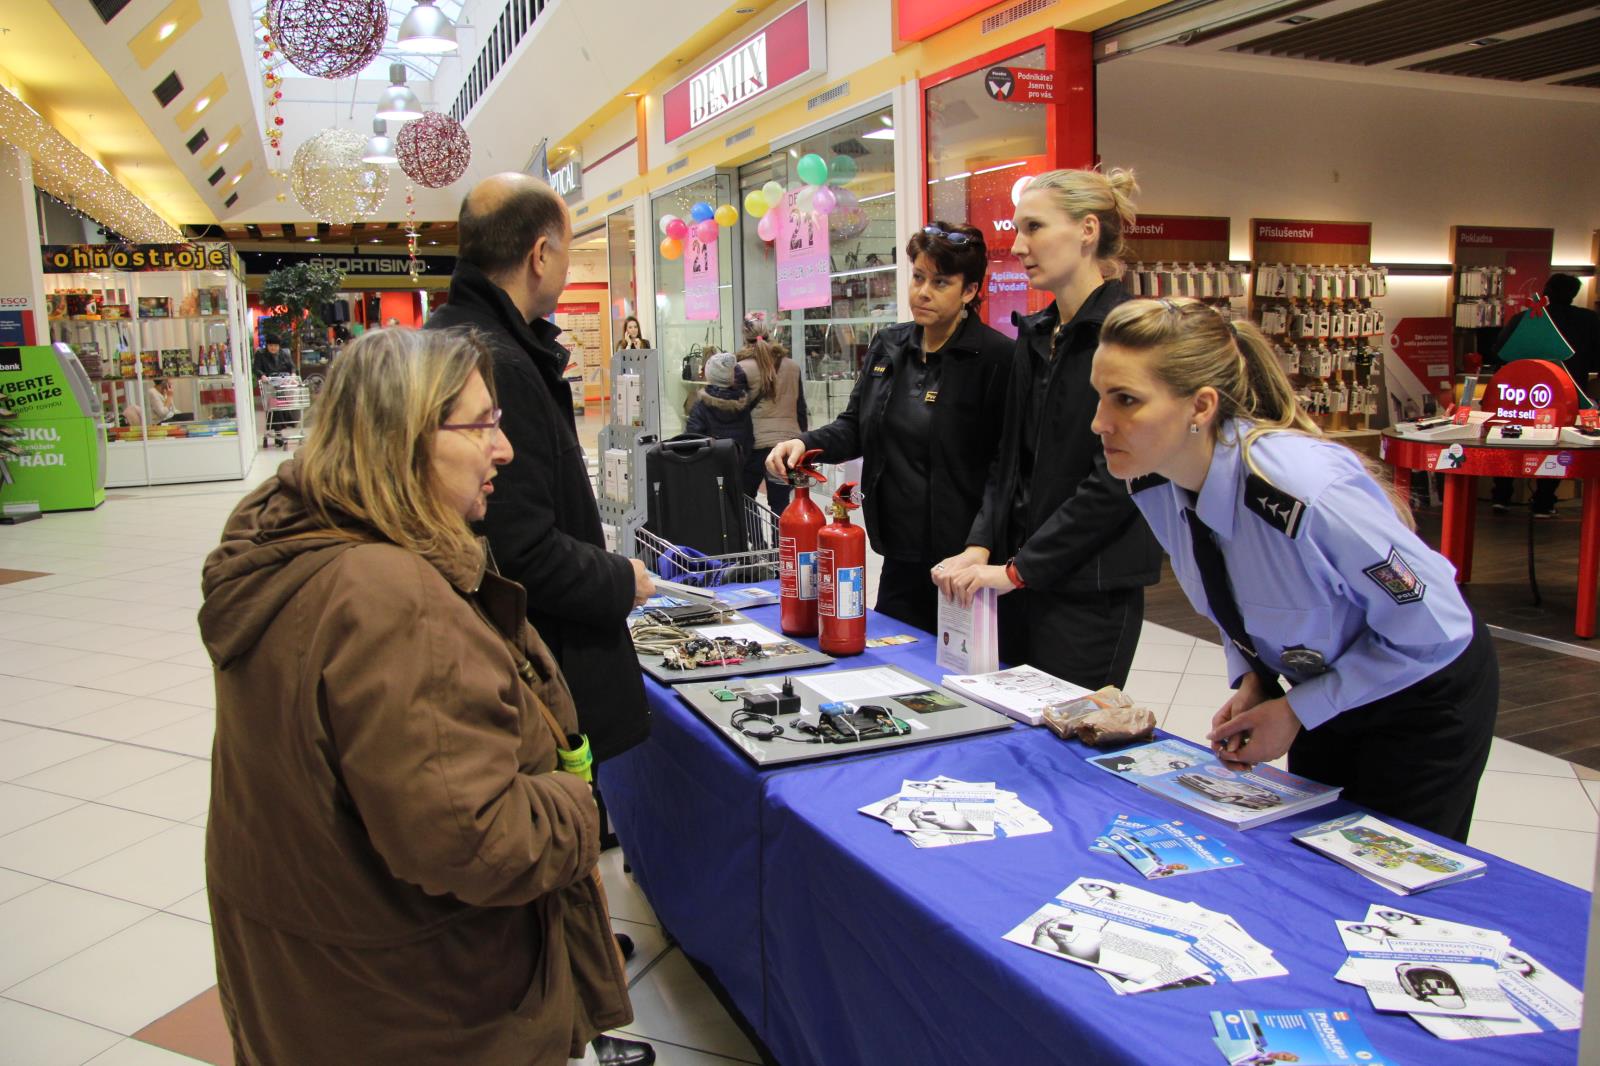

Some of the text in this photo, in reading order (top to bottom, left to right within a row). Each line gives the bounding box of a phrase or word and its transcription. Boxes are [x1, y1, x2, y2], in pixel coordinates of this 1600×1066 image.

[1017, 72, 1053, 82] Podnikáte?
[1027, 82, 1045, 90] Jsem
[1259, 226, 1314, 238] Příslušenství
[54, 245, 223, 270] ohňostroje
[309, 257, 426, 273] SPORTISIMO
[4, 387, 62, 410] peníze
[1497, 384, 1547, 405] Top 10
[1497, 408, 1517, 418] Best
